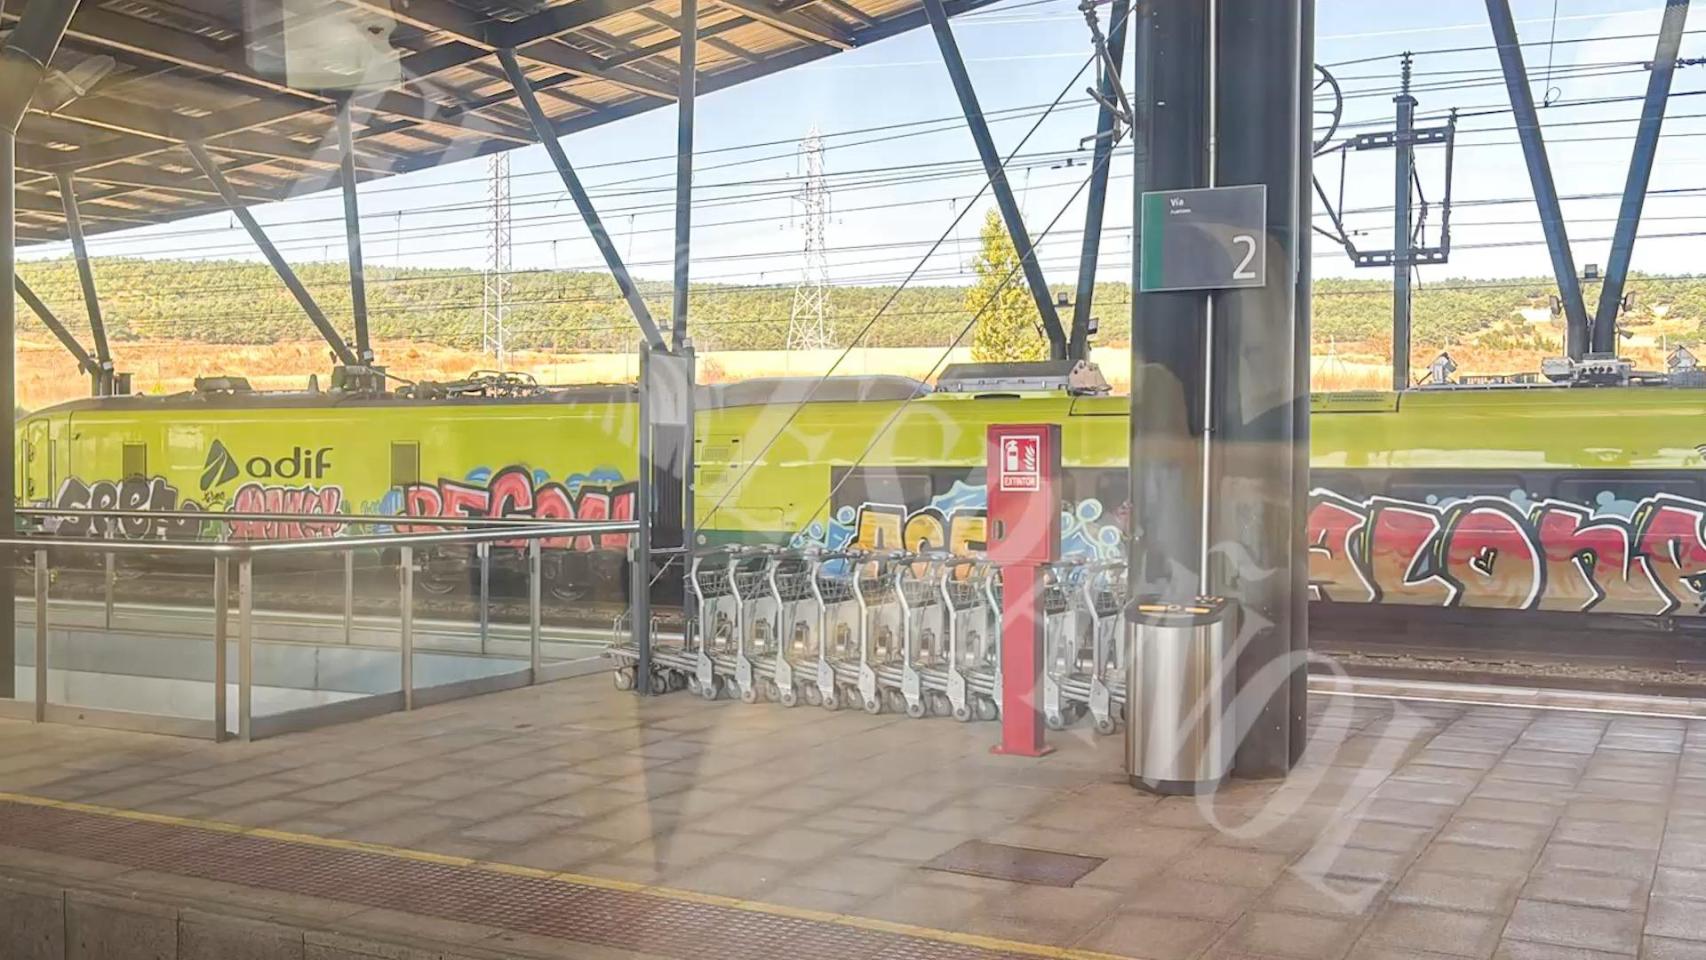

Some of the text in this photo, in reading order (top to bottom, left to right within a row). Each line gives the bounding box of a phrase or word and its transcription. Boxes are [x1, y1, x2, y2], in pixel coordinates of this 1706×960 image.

[1232, 235, 1257, 280] 2
[246, 447, 334, 479] adif
[1004, 476, 1036, 487] EXTINTOR
